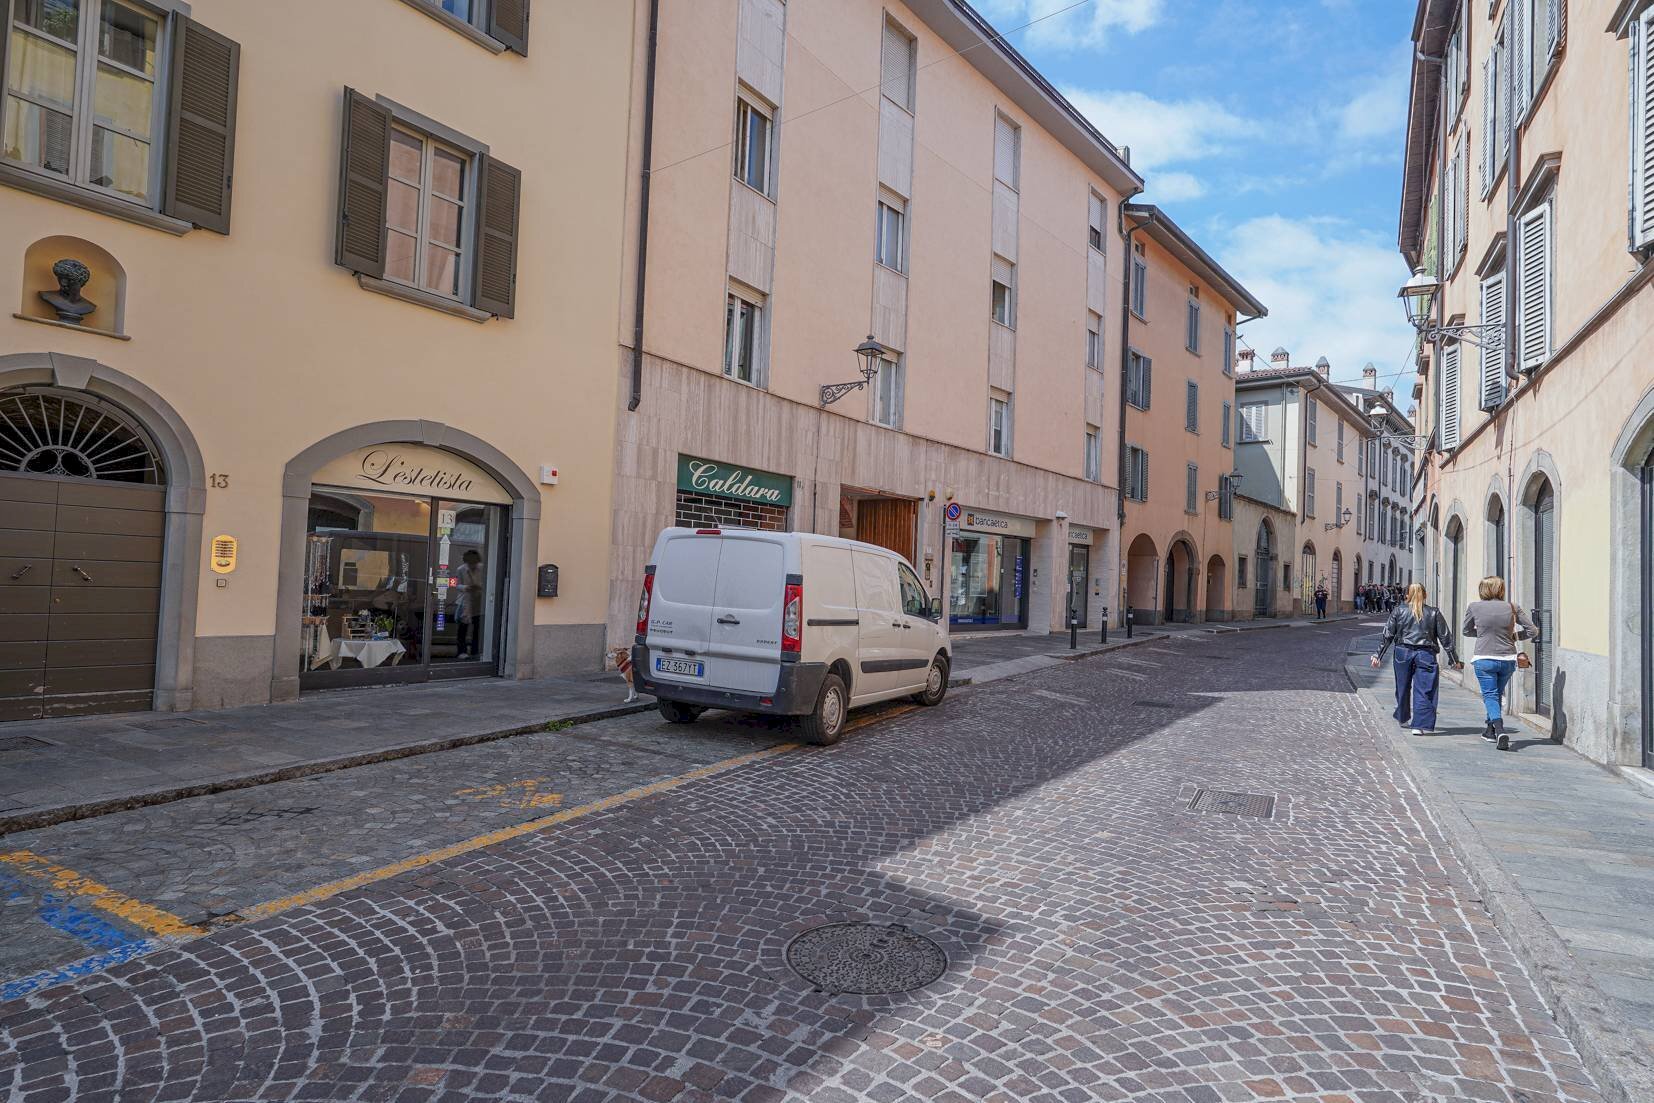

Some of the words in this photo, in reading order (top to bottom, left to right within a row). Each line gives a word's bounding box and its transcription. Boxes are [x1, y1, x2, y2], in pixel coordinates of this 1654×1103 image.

[355, 449, 474, 493] L'estetista
[209, 472, 230, 489] 13
[688, 460, 781, 501] Caldara
[442, 513, 454, 525] 13
[975, 516, 1009, 529] bancaetica
[661, 660, 671, 670] EZ
[673, 661, 697, 673] 367YT
